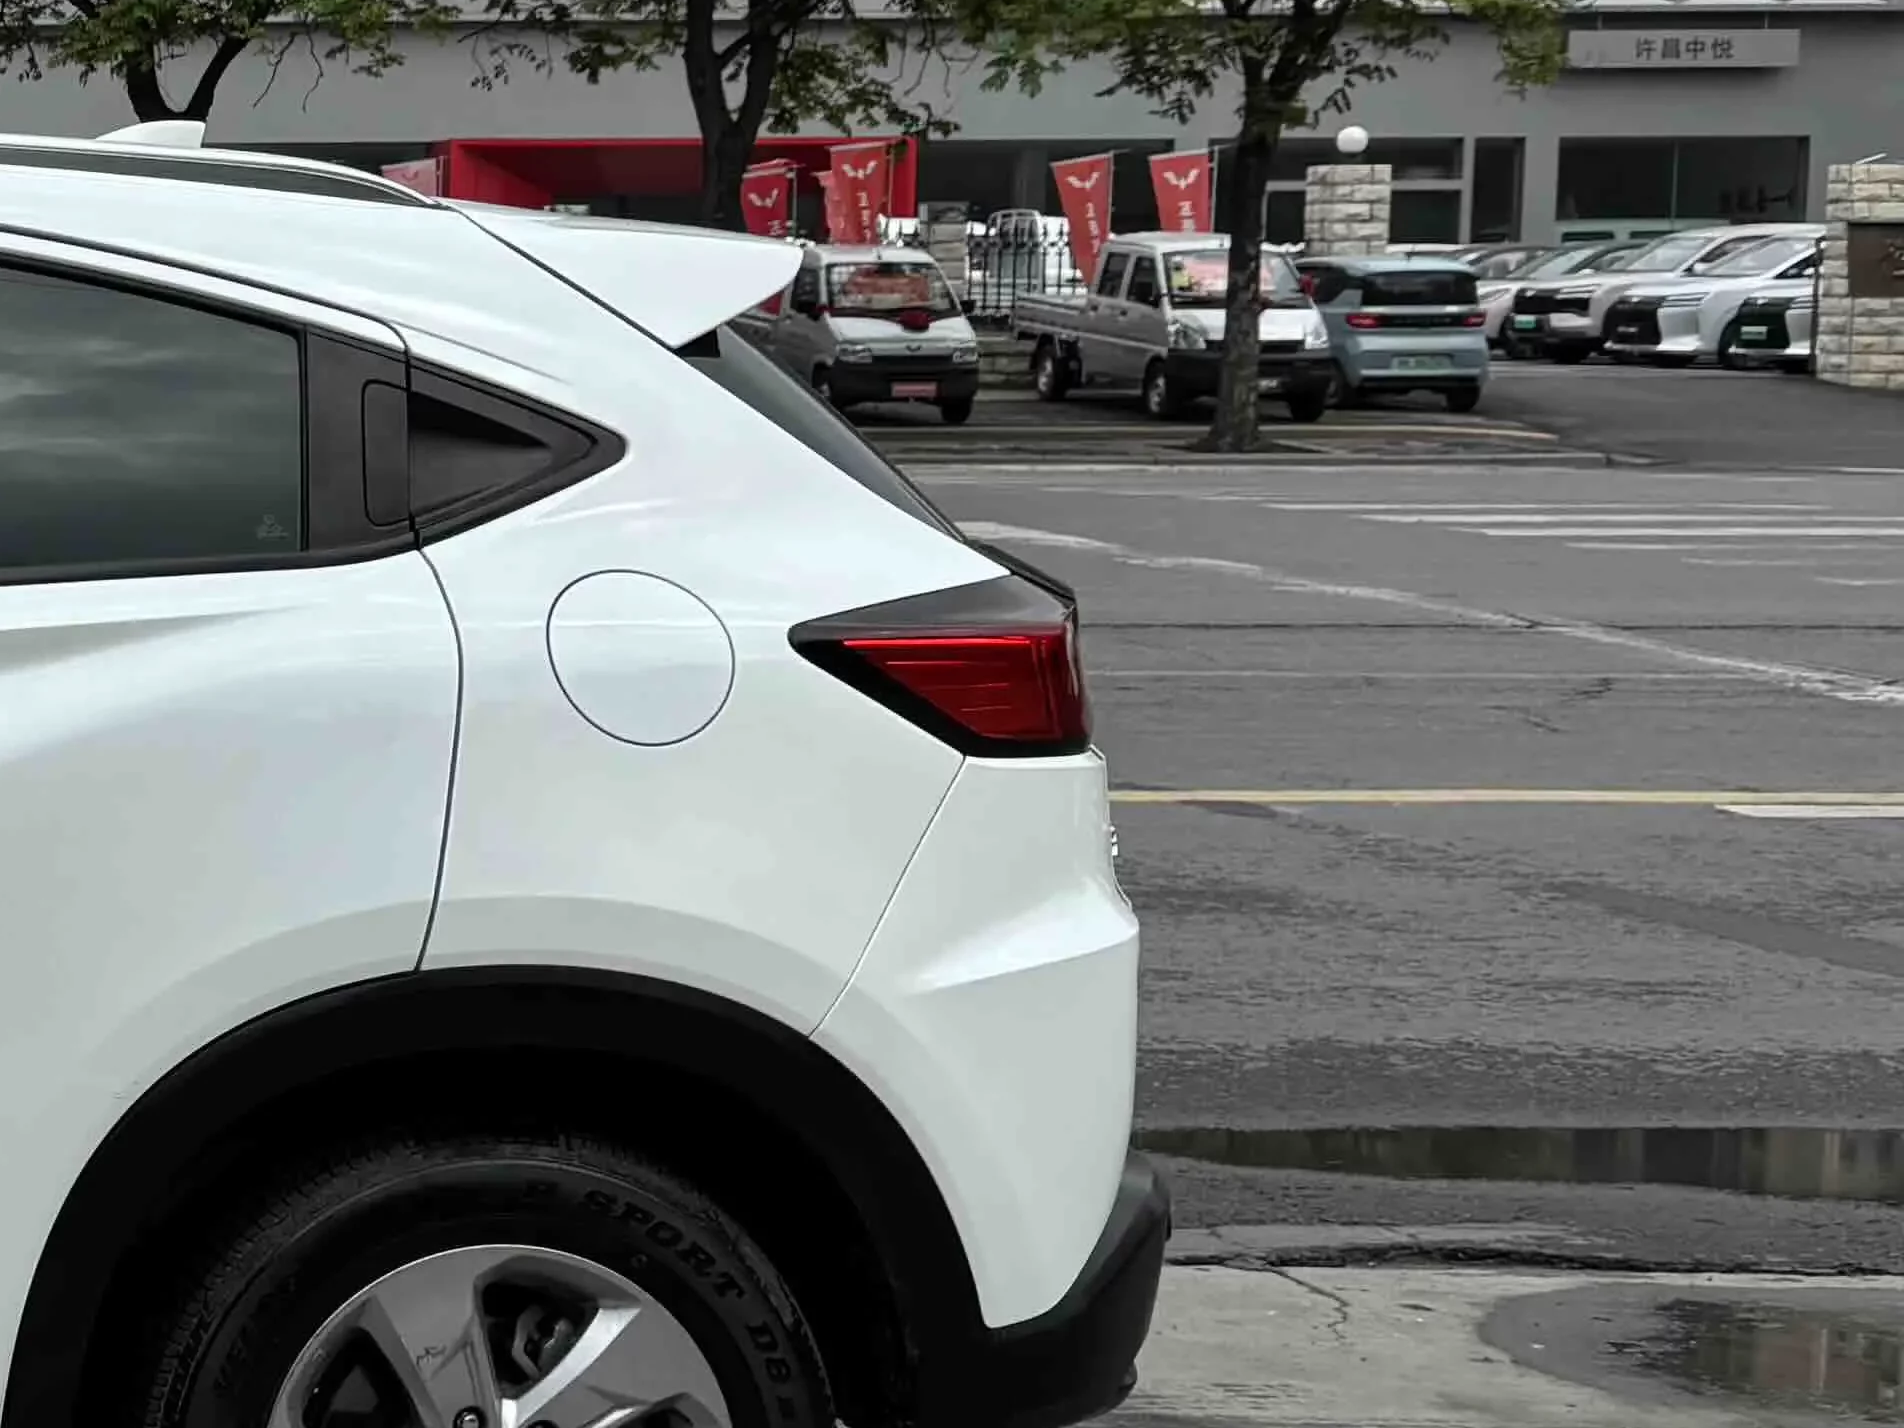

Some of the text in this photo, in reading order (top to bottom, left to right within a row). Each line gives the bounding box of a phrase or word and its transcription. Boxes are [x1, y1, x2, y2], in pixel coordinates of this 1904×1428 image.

[1634, 37, 1735, 61] 许昌中悦
[576, 1188, 747, 1302] SPORT
